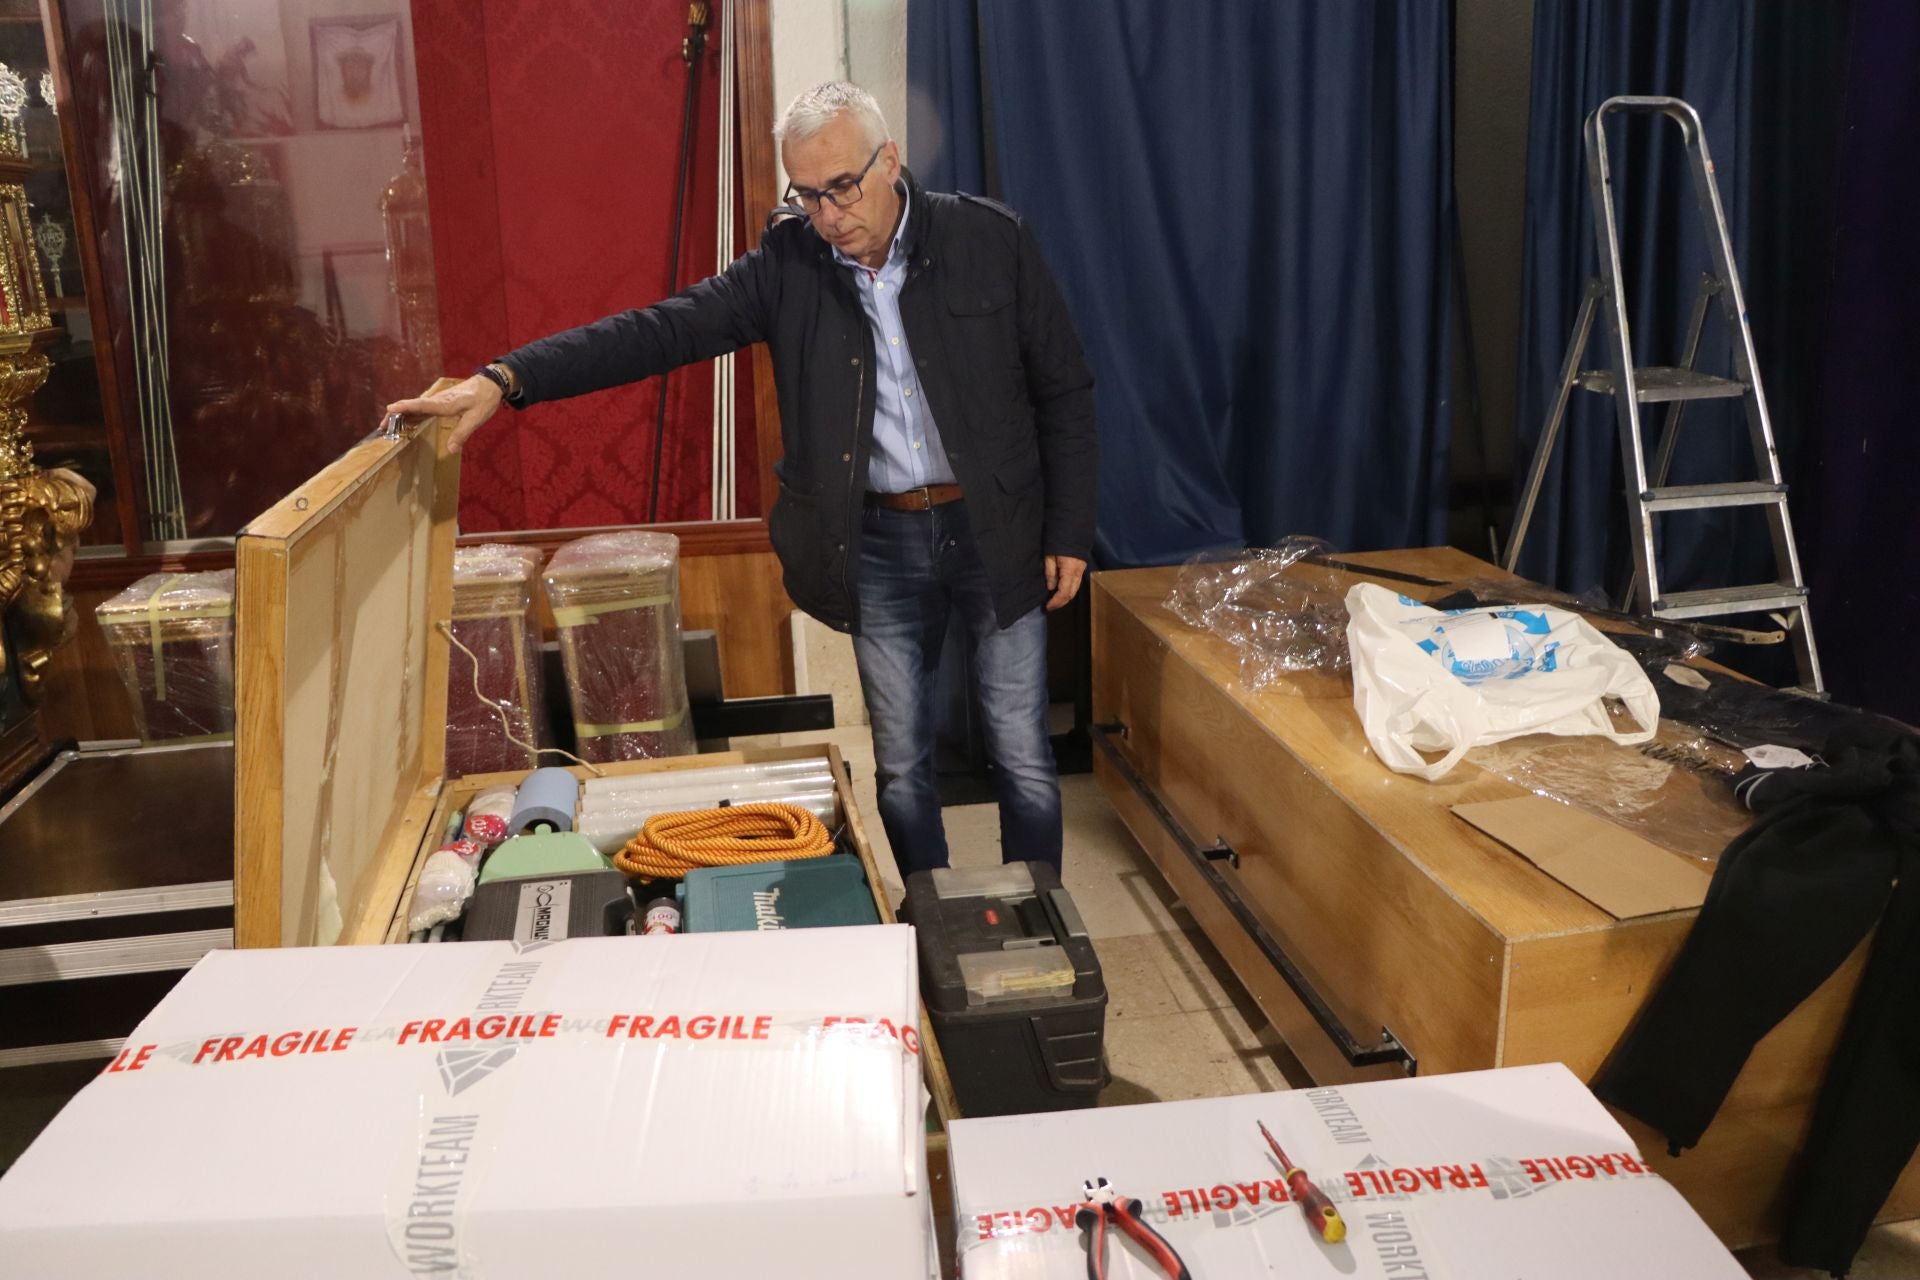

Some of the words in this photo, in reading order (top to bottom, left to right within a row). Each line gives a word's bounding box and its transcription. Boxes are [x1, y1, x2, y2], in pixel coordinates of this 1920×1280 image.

[474, 961, 543, 1016] RKTEAM
[192, 1027, 358, 1065] FRAGILE
[397, 1014, 563, 1046] FRAGILE
[606, 1014, 773, 1040] FRAGILE
[404, 1114, 480, 1275] WORKTEAM
[1161, 1178, 1291, 1217] RAGILE
[1343, 1163, 1490, 1197] FRAGILE
[976, 1202, 1080, 1240] AGILE
